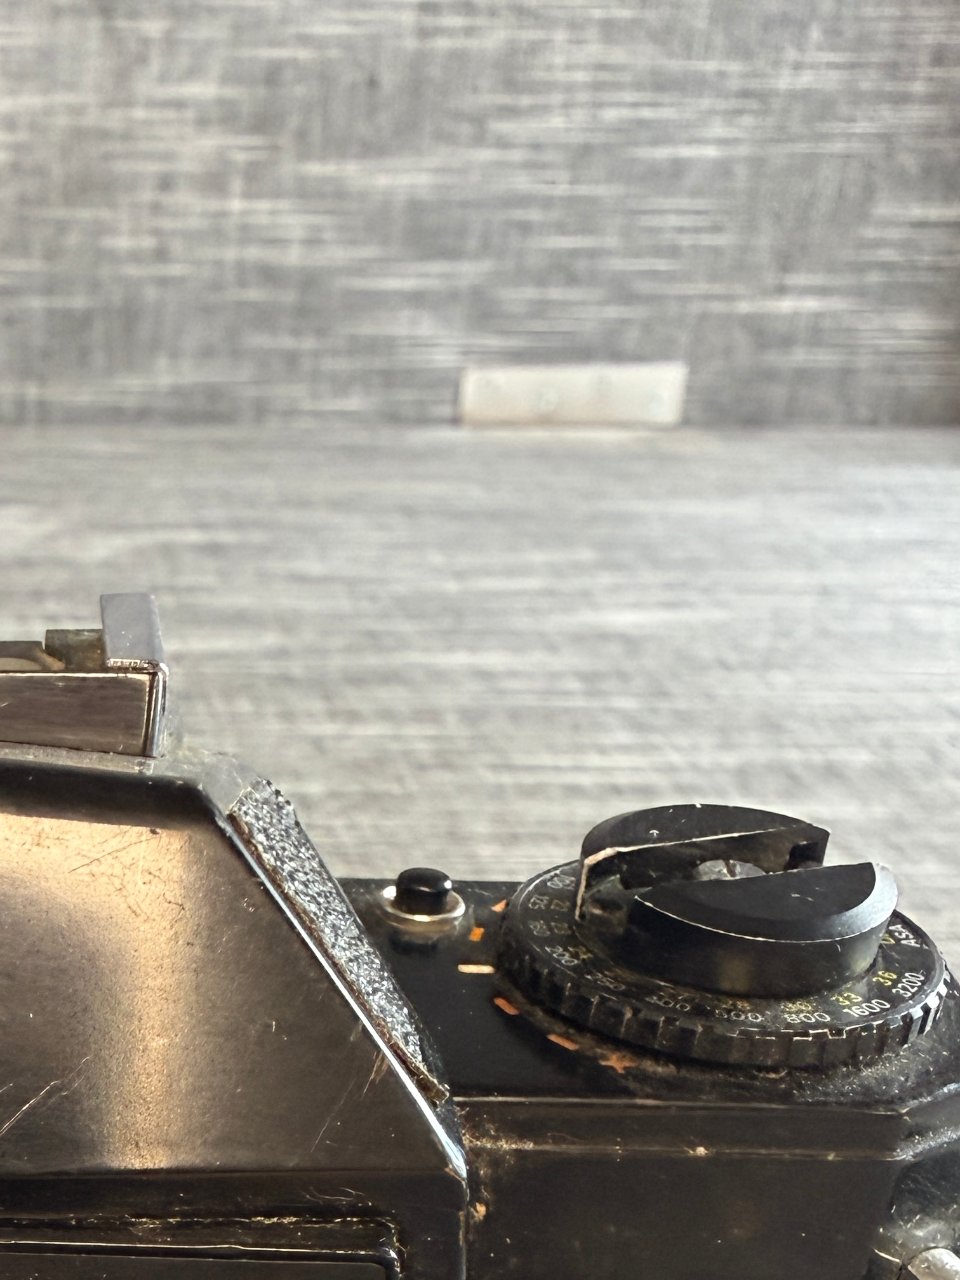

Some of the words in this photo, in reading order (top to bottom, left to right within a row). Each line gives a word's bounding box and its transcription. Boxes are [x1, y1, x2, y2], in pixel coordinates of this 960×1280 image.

[889, 924, 921, 948] ASA
[872, 970, 897, 986] 36
[892, 971, 926, 999] 3200
[831, 992, 862, 1006] 33
[842, 998, 891, 1018] 1600
[784, 1011, 831, 1024] 800
